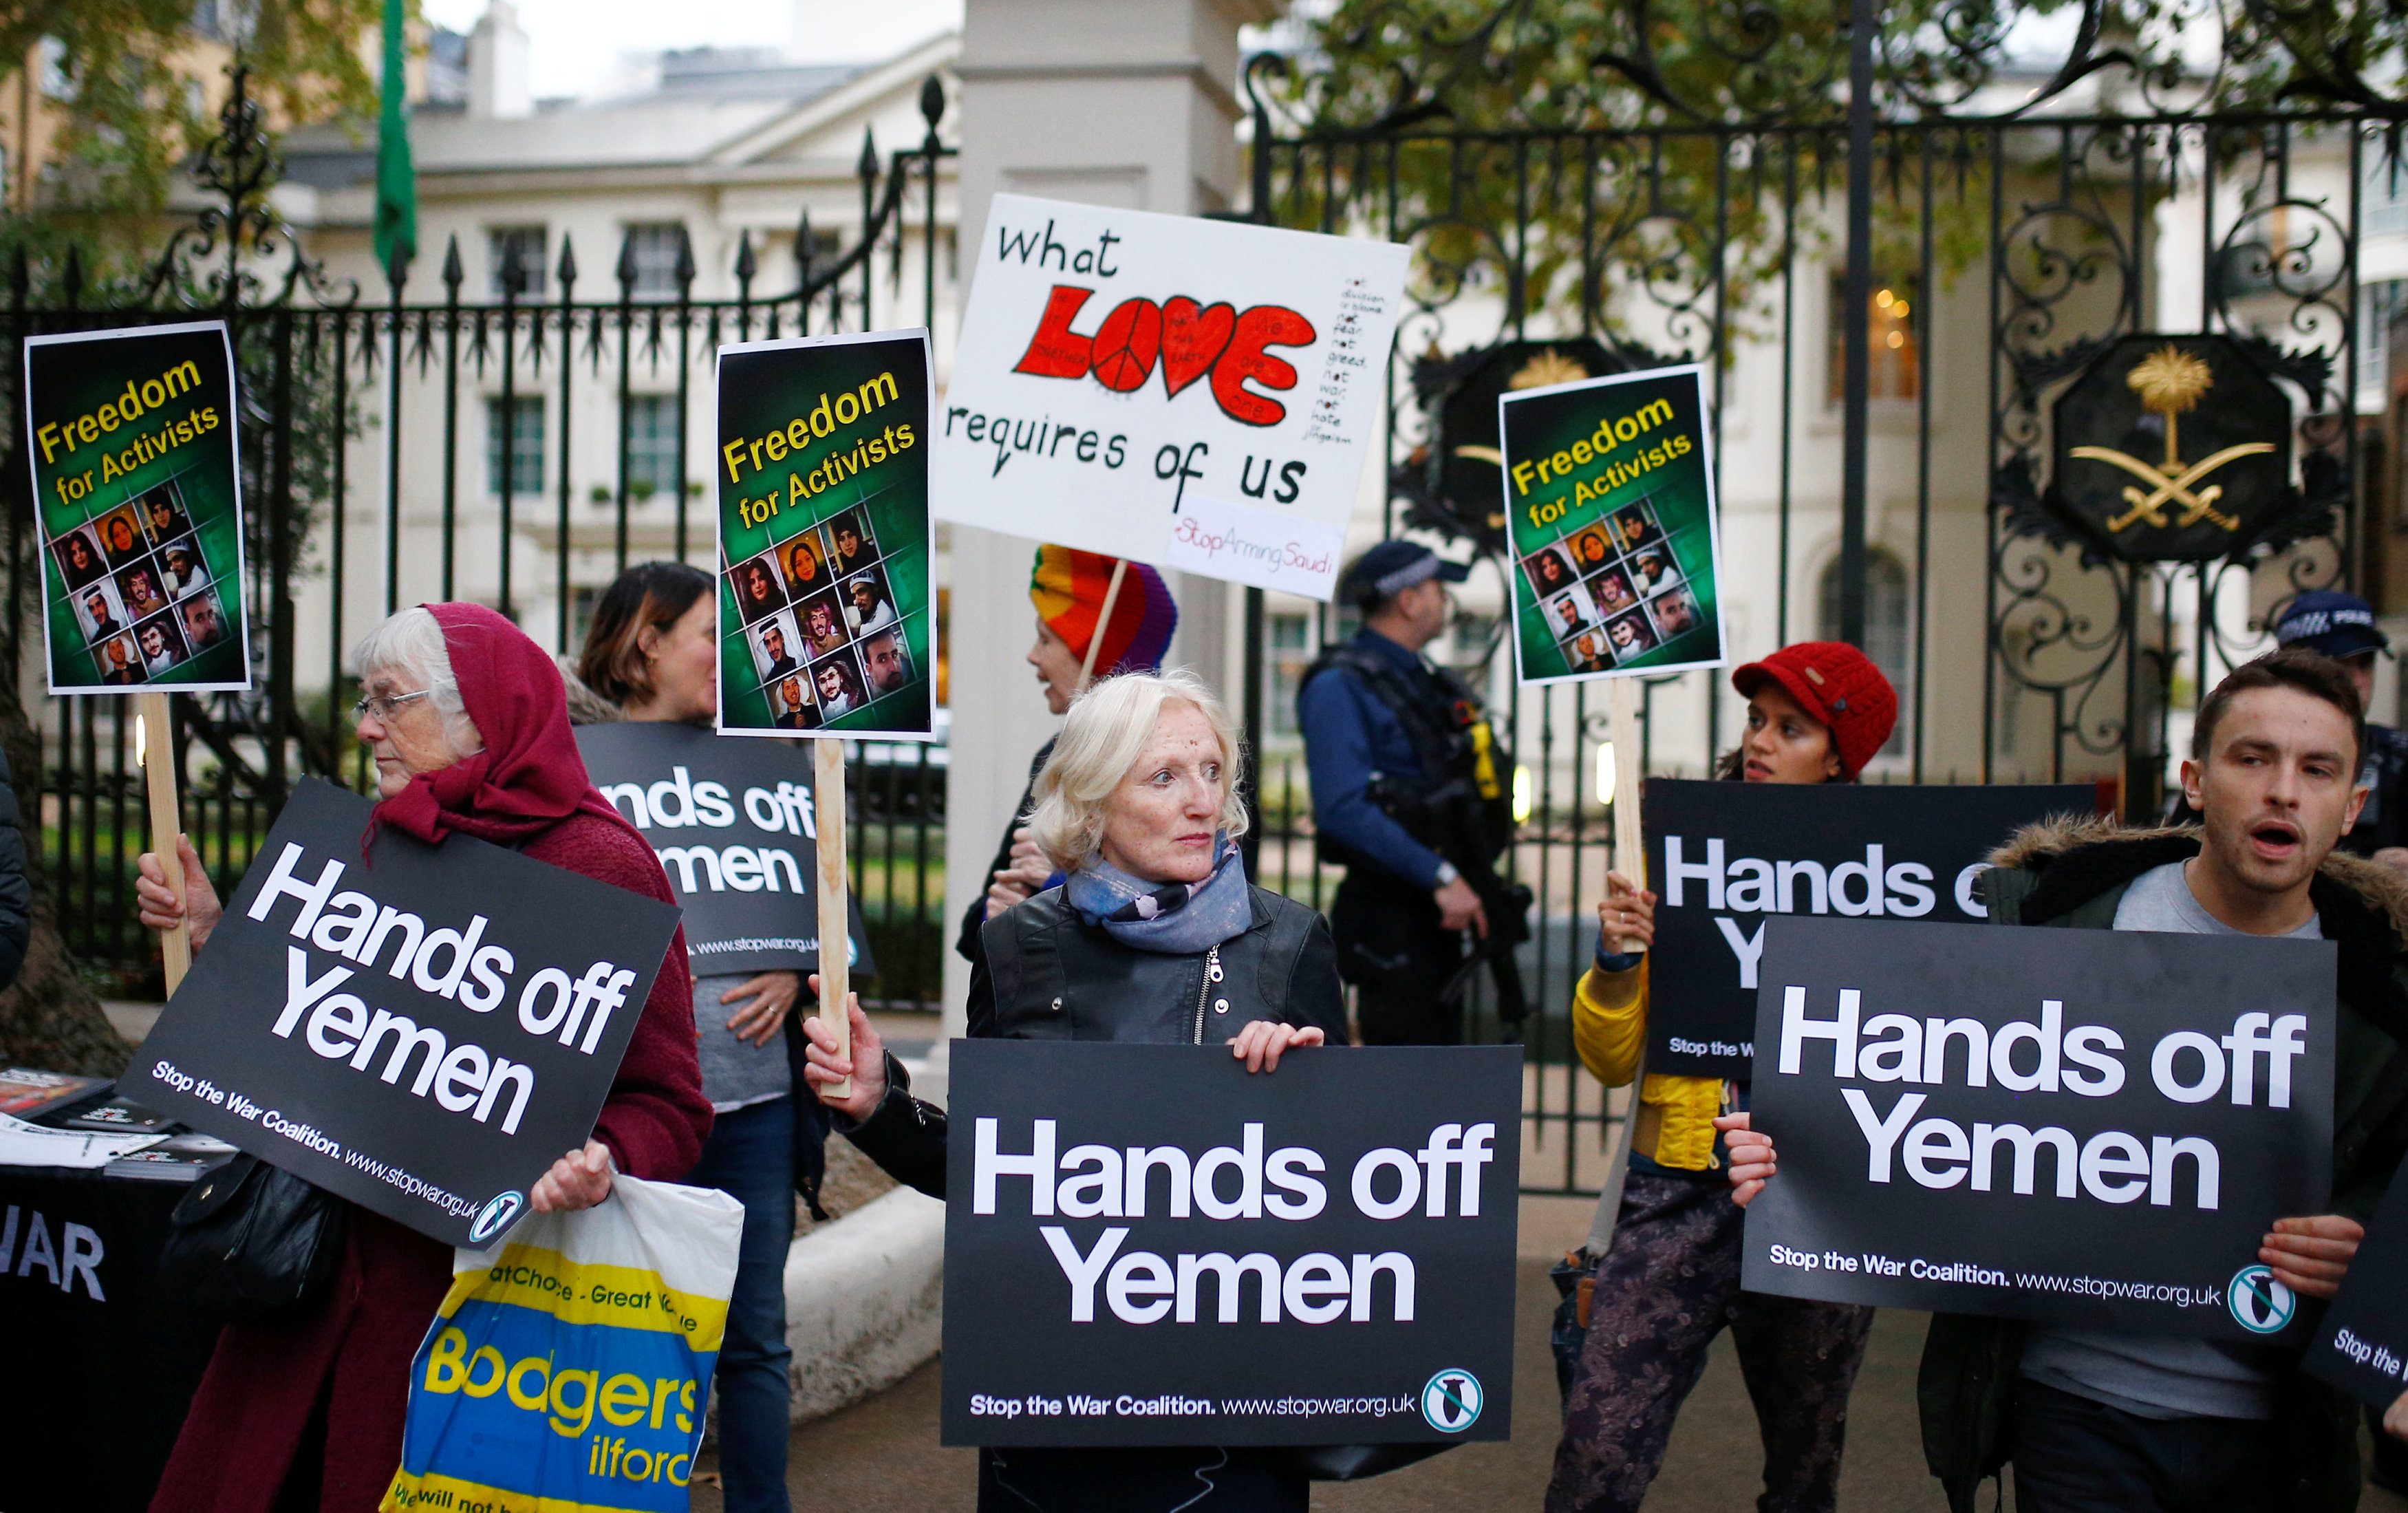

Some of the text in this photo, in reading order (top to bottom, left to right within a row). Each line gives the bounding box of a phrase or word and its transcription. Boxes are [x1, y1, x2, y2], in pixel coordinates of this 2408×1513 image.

[1011, 284, 1317, 427] LOVE
[37, 360, 201, 464] Freedom
[56, 406, 219, 505] for Activists
[723, 372, 899, 483] Freedom
[945, 405, 1307, 515] requires of us
[1512, 398, 1674, 496] Freedom
[739, 424, 915, 529] for Activists
[1528, 434, 1692, 528] for Activists
[599, 765, 817, 839] nds off
[656, 844, 805, 894] men
[1664, 835, 1936, 919] Hands
[246, 840, 637, 1055] Hands off
[696, 937, 819, 954] www.stopwar.org.uk
[271, 945, 535, 1135] Yemen
[1669, 1037, 1708, 1058] Stop
[1710, 1041, 1738, 1057] the
[1777, 985, 2308, 1109] Hands off
[152, 1060, 481, 1220] Stop the War Coalition. www.stopwar.org.uk
[972, 1117, 1496, 1221] Hands off
[1840, 1088, 2220, 1211] Yemen
[591, 1285, 652, 1309] Great
[1039, 1225, 1416, 1324] Yemen
[1770, 1244, 2222, 1307] Stop the War Coalition. www.stopwar.org.uk
[2334, 1328, 2372, 1364] Stop
[2372, 1346, 2400, 1375] the
[970, 1393, 1416, 1419] Stop the War Coalition. www.stopwar.org.uk
[418, 1488, 454, 1509] will
[459, 1499, 493, 1513] not
